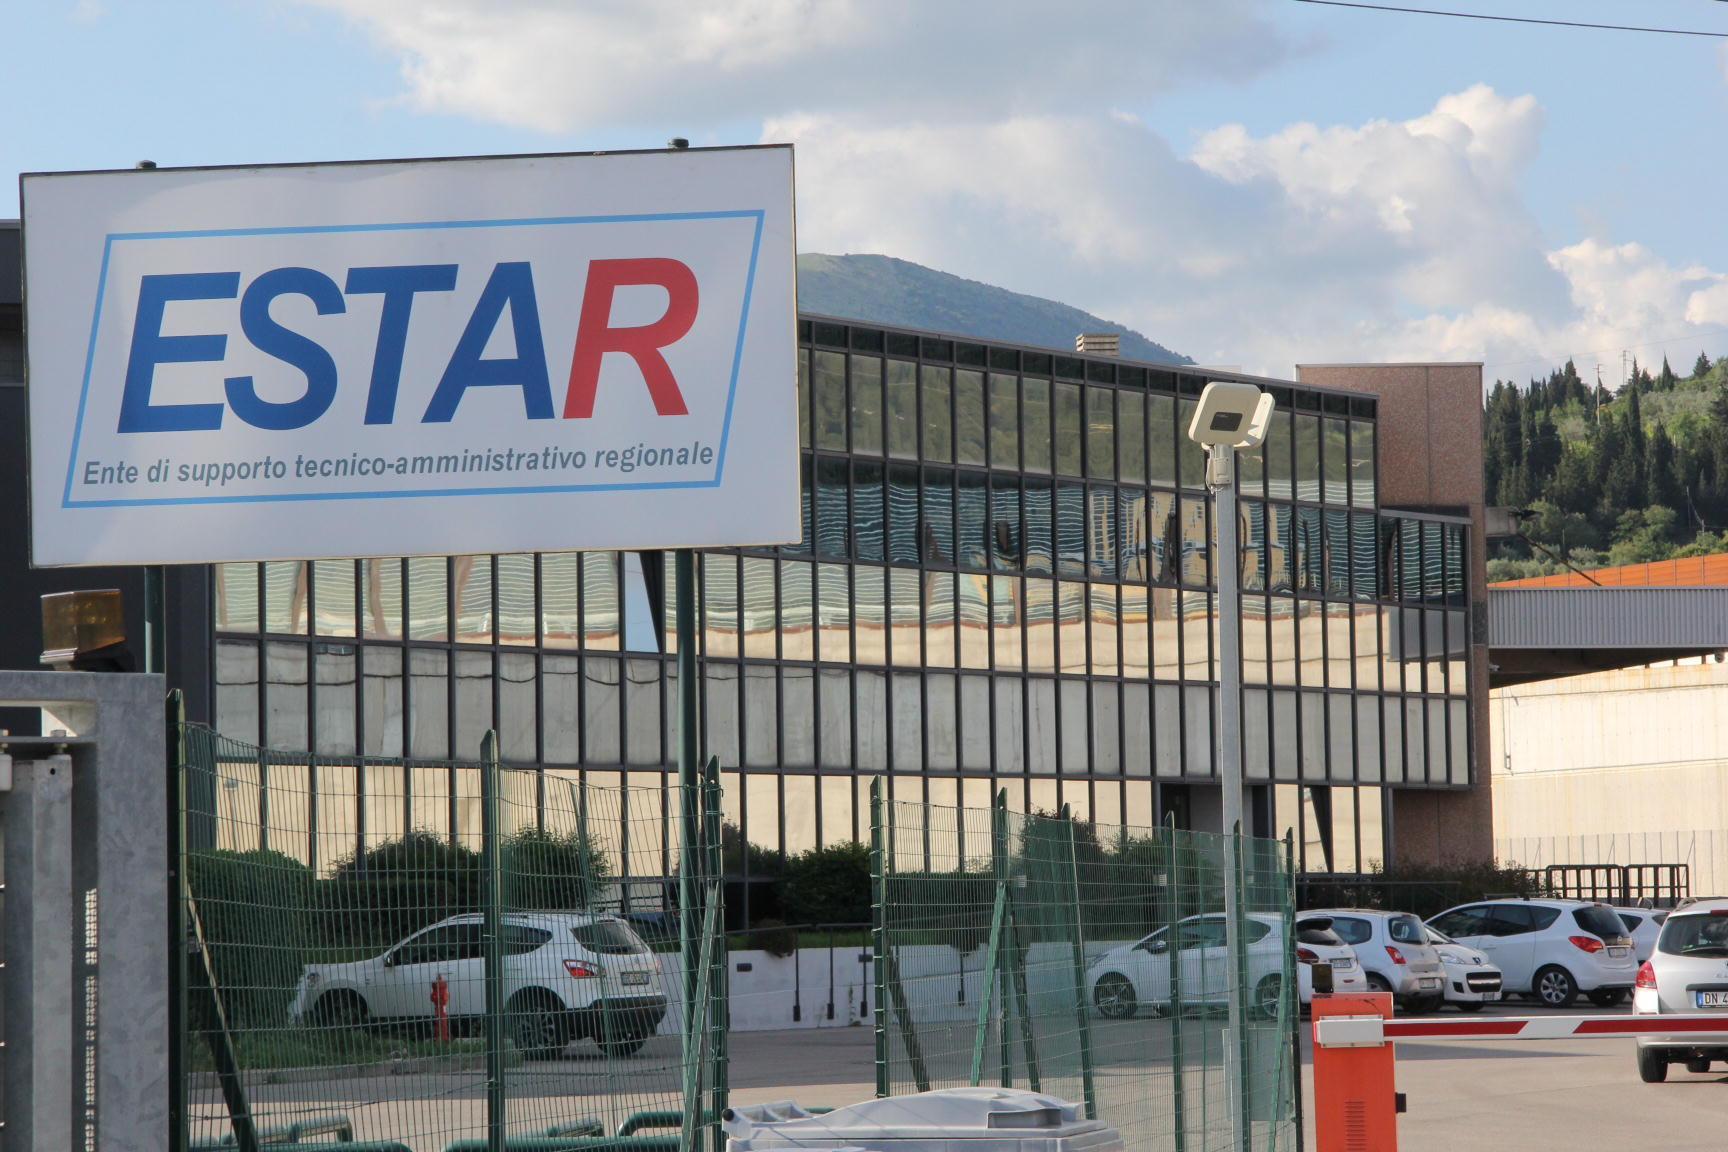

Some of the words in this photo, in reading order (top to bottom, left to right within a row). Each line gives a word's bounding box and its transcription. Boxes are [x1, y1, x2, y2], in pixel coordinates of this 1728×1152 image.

[118, 258, 699, 433] ESTAR
[84, 461, 138, 484] Ente
[147, 459, 170, 482] di
[177, 456, 287, 486] supporto
[295, 446, 587, 478] tecnico-amministrativo
[594, 442, 714, 473] regionale
[1704, 992, 1718, 1005] DN
